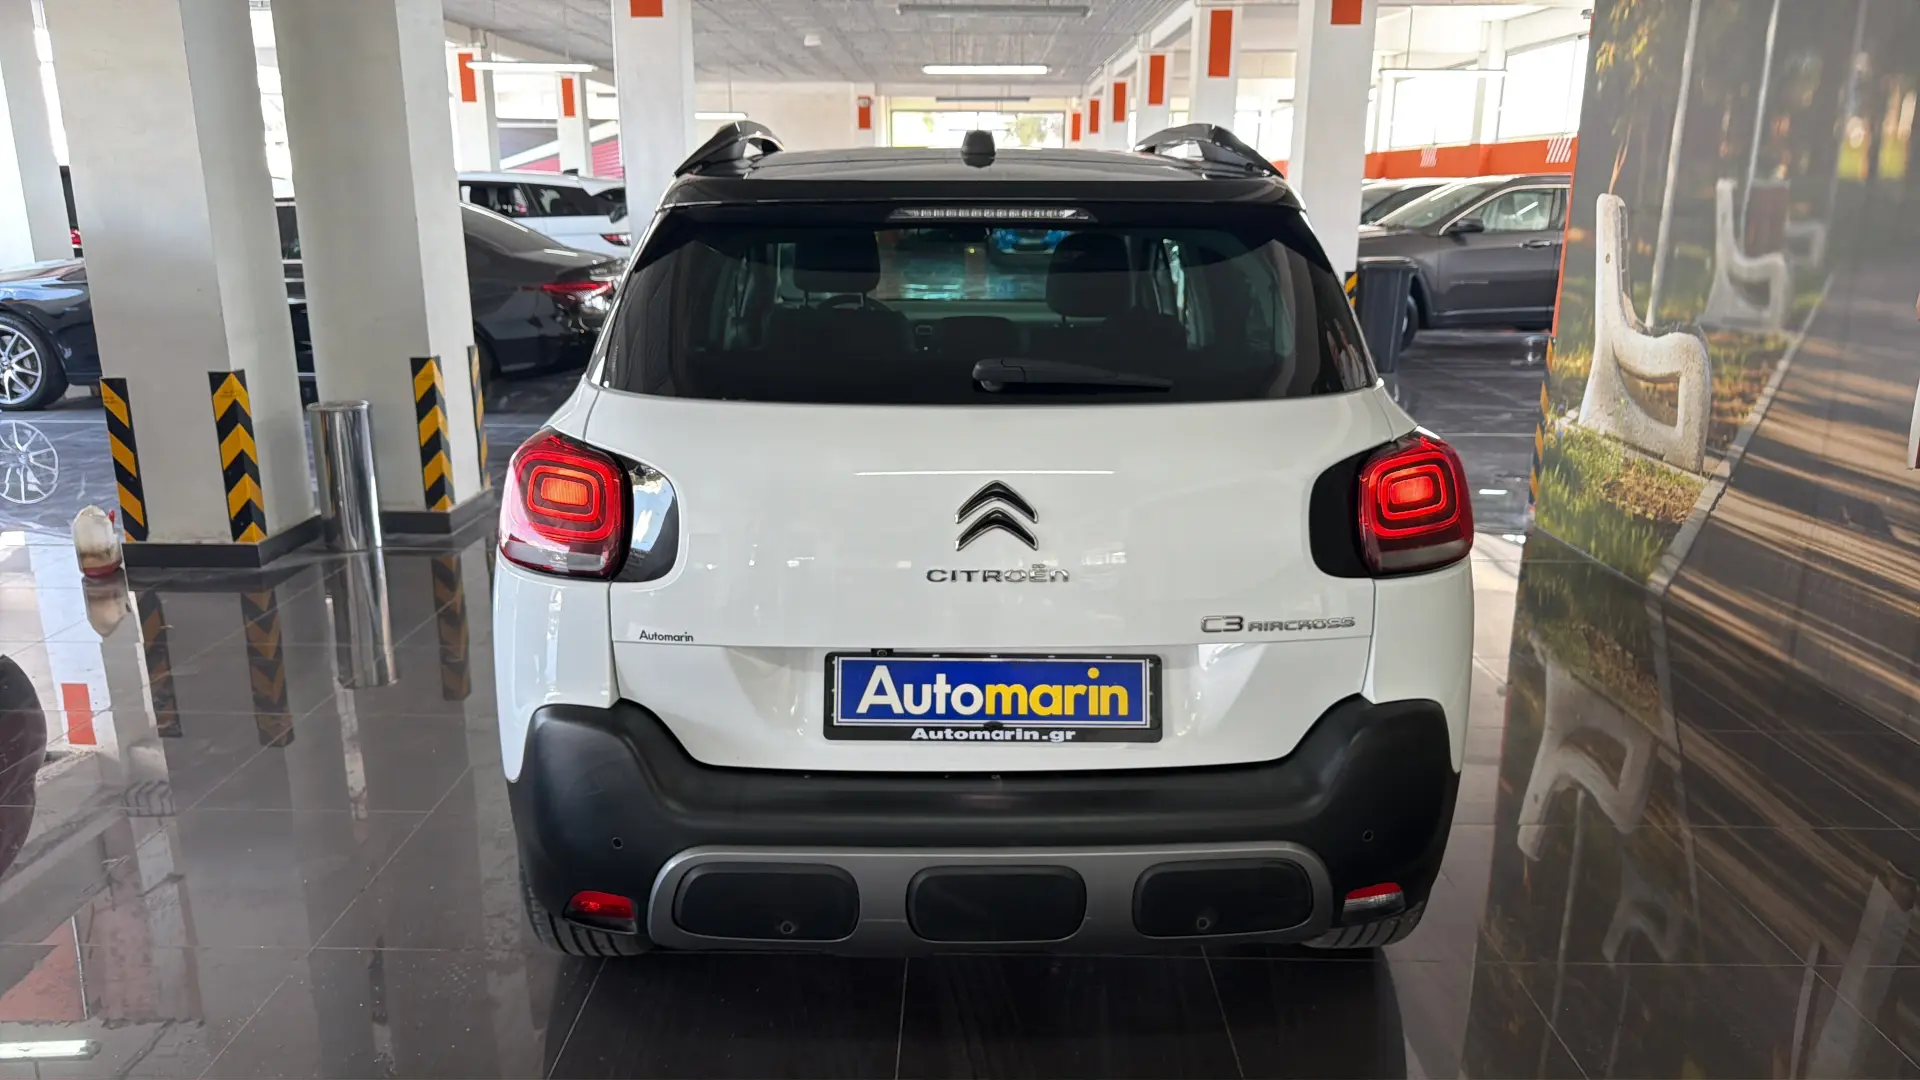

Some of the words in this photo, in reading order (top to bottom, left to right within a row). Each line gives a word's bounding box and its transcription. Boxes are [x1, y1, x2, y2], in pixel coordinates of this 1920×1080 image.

[1200, 615, 1244, 633] C3
[1248, 616, 1356, 632] AIRCROSS
[639, 629, 694, 642] Automarin
[856, 665, 1129, 716] Automarin
[911, 727, 1077, 743] Automarin.gr
